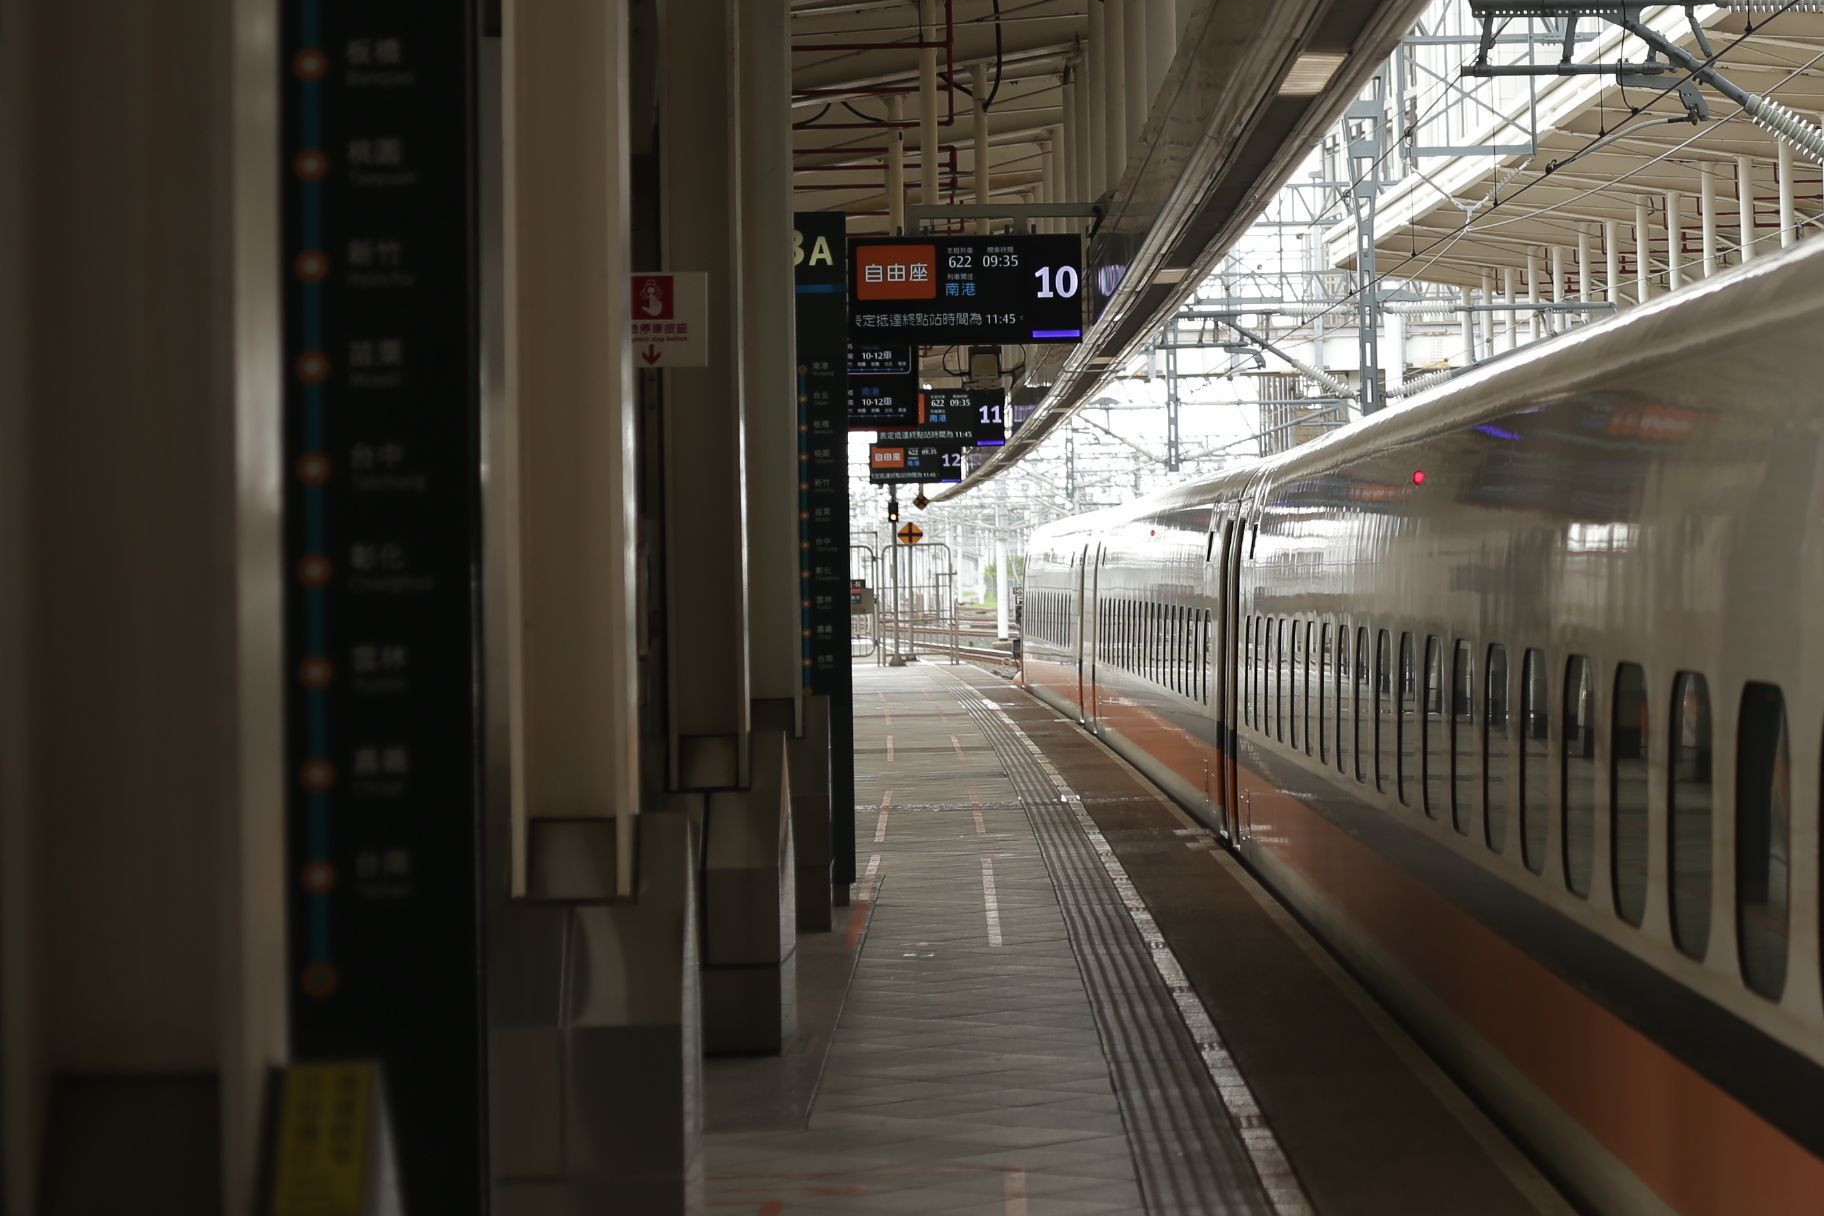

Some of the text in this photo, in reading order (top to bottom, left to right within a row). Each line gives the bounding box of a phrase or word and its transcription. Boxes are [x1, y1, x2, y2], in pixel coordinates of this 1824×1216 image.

[949, 254, 1018, 268] 622 09:35
[865, 263, 928, 282] 自由座
[1034, 265, 1078, 298] 10
[945, 282, 976, 297] 南港
[931, 398, 970, 407] 622 09:35
[979, 405, 1002, 424] 11
[942, 453, 961, 467] 12
